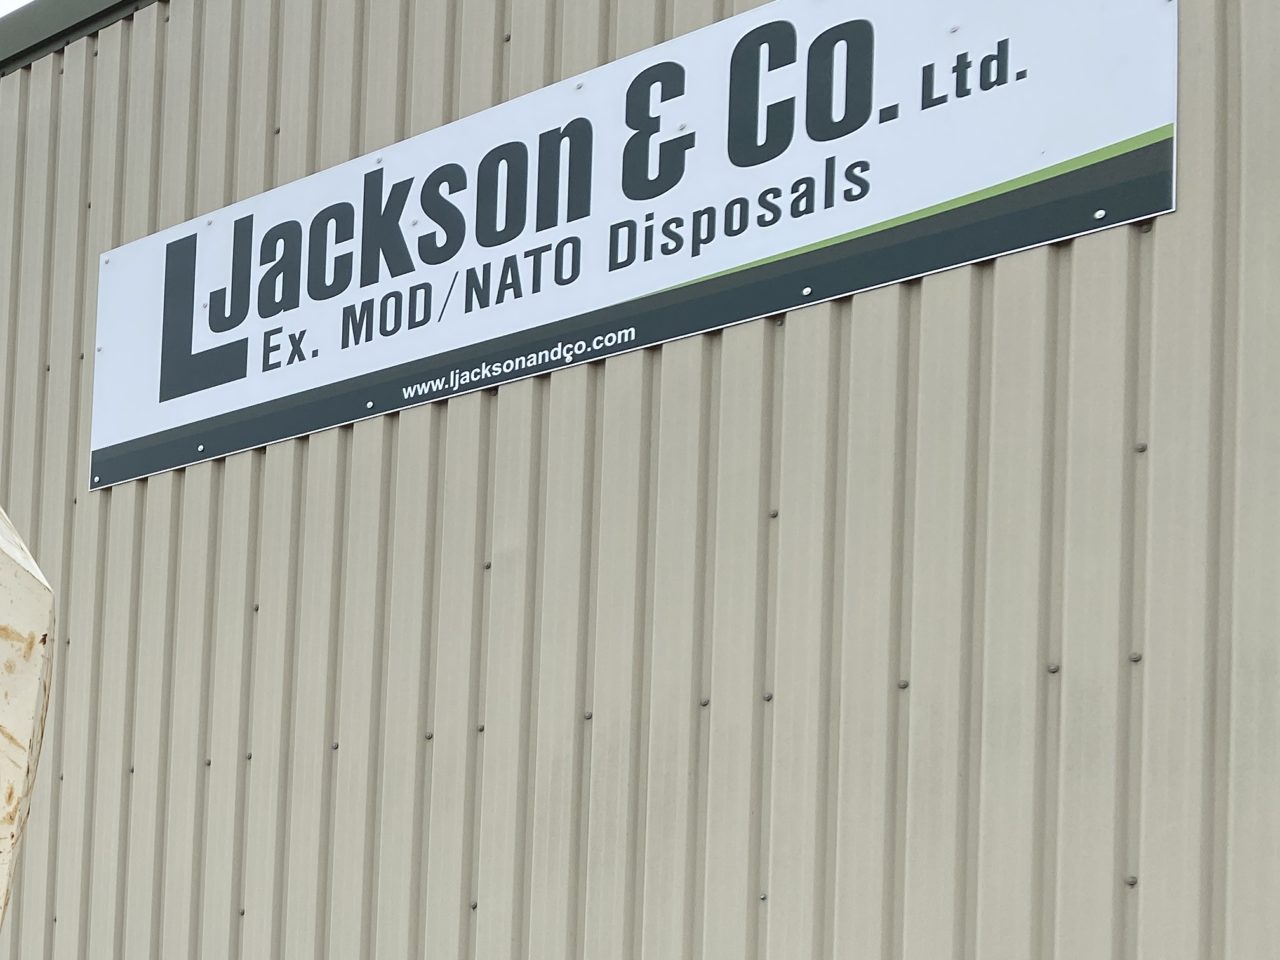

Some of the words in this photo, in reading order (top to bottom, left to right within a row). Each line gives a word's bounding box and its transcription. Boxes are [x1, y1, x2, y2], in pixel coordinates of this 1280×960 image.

[621, 61, 696, 201] &
[727, 19, 900, 168] Co.
[921, 38, 1028, 110] Ltd.
[261, 326, 319, 373] Ex.
[608, 156, 871, 273] Disposals
[402, 326, 637, 400] www.ljacksonandco.com
